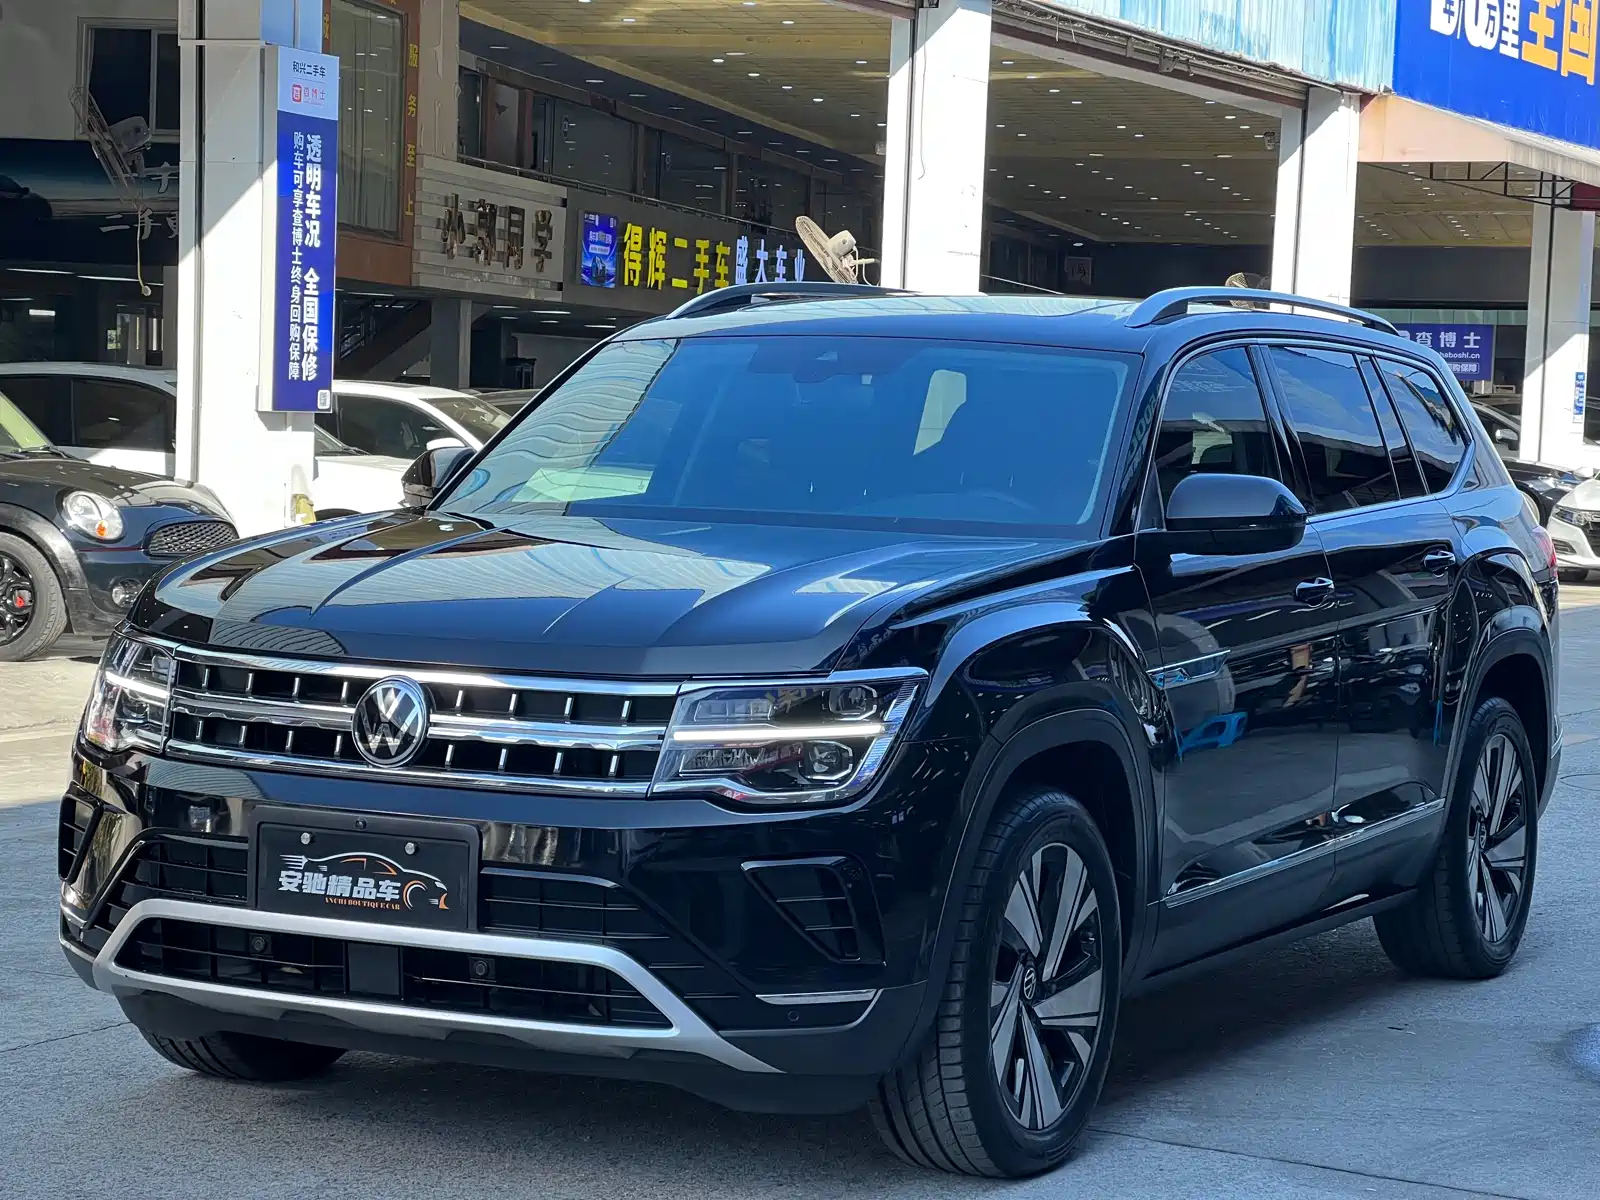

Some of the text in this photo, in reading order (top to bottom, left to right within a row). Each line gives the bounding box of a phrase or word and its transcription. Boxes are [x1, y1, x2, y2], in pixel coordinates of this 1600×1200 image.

[292, 61, 327, 78] 和兴二手车
[404, 43, 419, 217] 服务至上
[288, 131, 304, 381] 购车可享查博士终身回购保障
[301, 133, 322, 382] 透明车况 全国保修
[623, 222, 732, 295] 得辉二手车
[1415, 331, 1481, 349] 查博士
[278, 870, 402, 902] 安驰精品车
